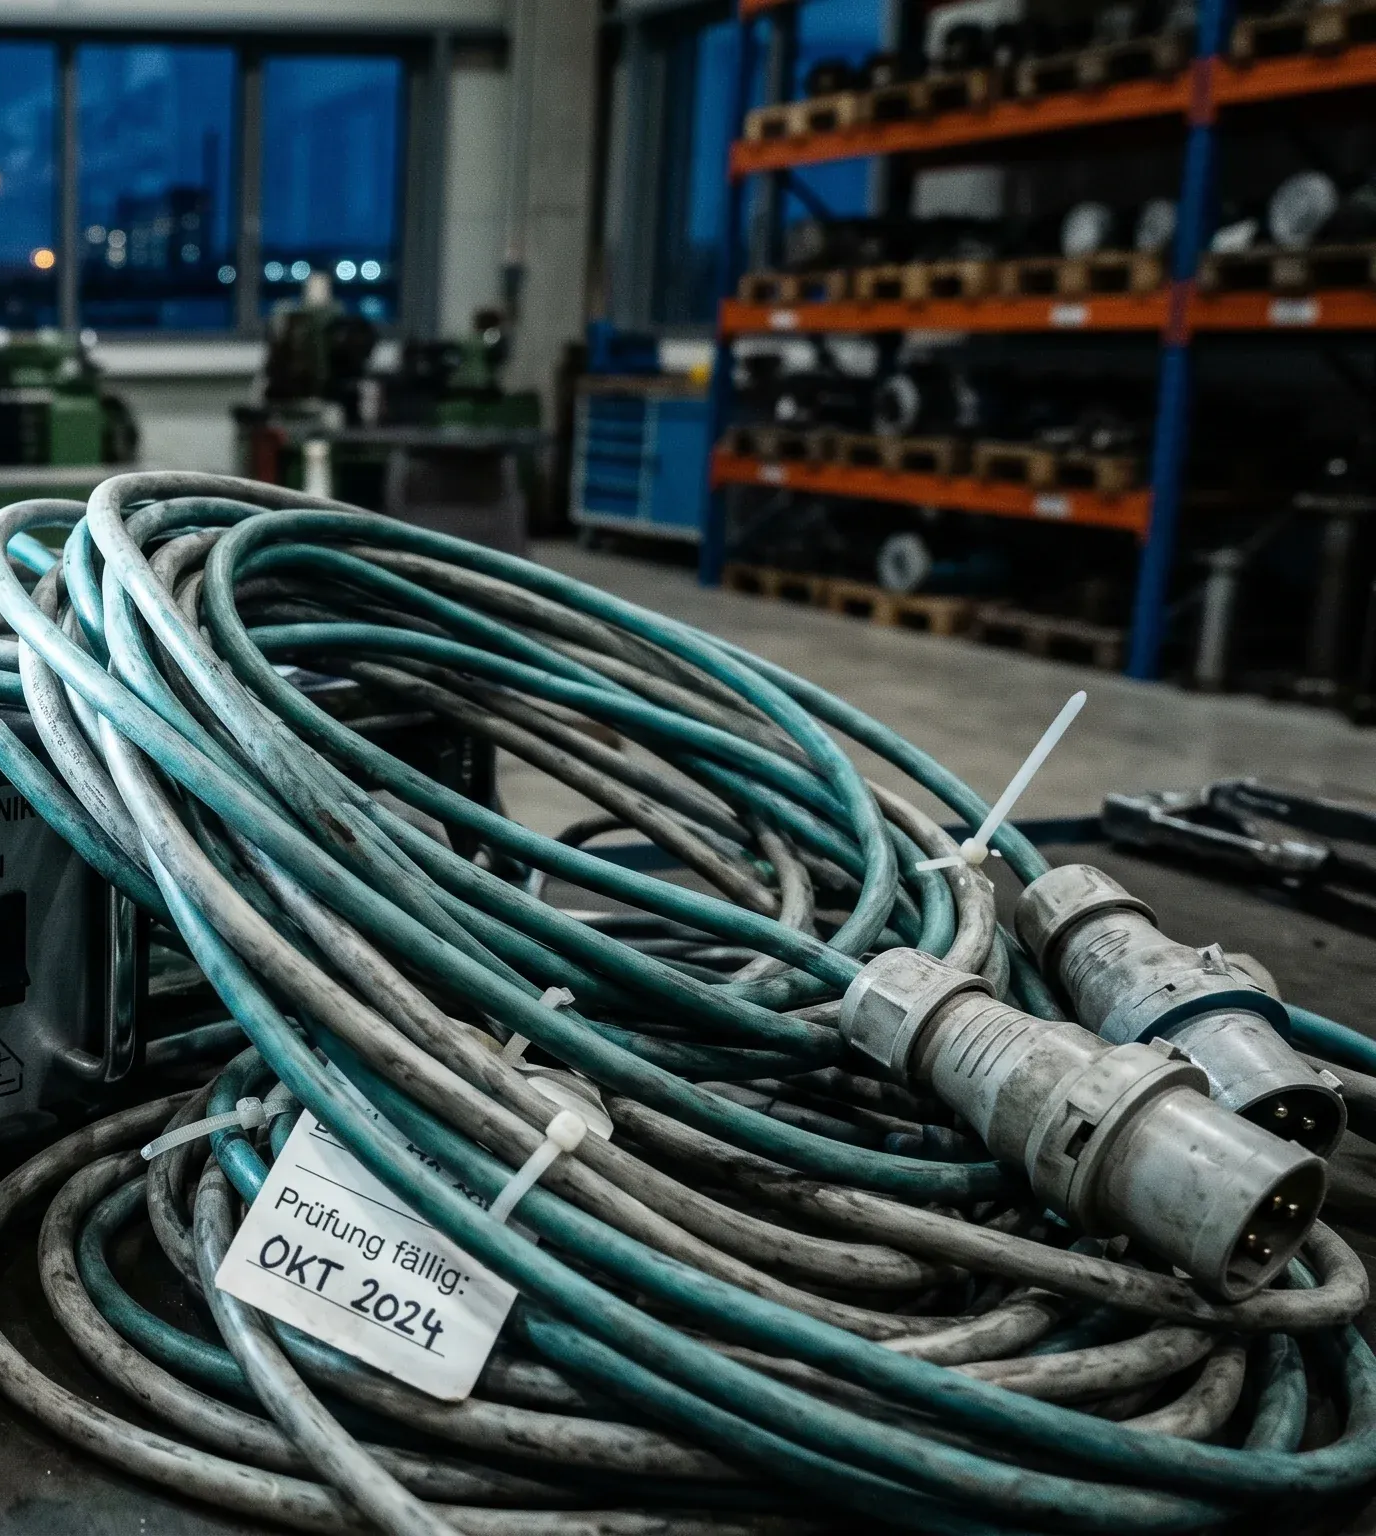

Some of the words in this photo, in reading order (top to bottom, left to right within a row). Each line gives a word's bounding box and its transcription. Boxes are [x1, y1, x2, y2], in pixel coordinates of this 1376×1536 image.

[259, 1234, 344, 1292] OKT
[350, 1278, 444, 1350] 2024
[274, 1187, 386, 1261] Prüfung
[392, 1240, 471, 1296] fällig:
